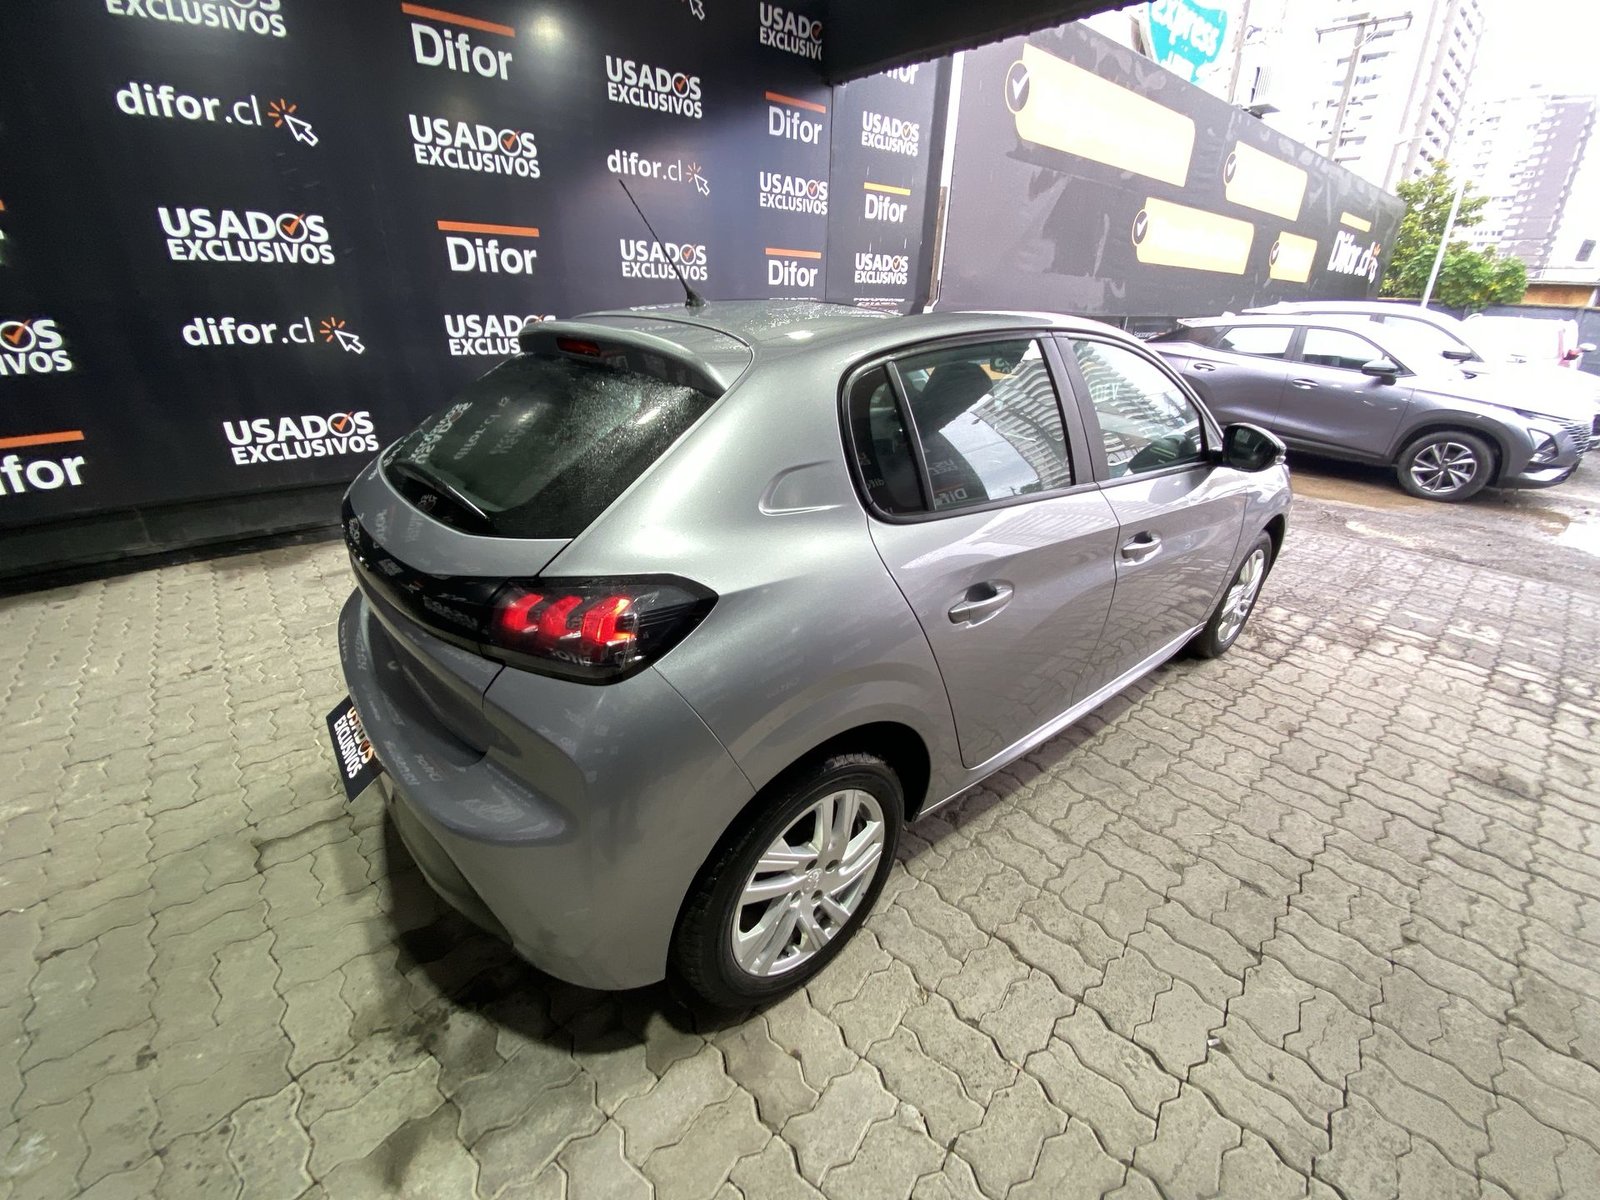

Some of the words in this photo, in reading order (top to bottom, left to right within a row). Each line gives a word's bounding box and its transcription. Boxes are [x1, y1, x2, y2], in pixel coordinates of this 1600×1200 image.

[105, 0, 287, 37] EXCLUSIVOS
[411, 22, 513, 80] Difor
[759, 27, 822, 61] EXCLUSIV
[605, 55, 702, 100] USADOS
[116, 82, 262, 126] difor.cl
[607, 82, 703, 119] EXCLUSIVOS
[408, 113, 538, 158] USADOS
[768, 105, 823, 144] Difor
[862, 110, 920, 142] USADOS
[413, 143, 541, 178] EXCLUSIVOS
[861, 131, 919, 157] EXCLUSIVOS
[606, 149, 682, 182] difor.cl
[759, 171, 828, 200] USADOS
[759, 193, 828, 215] EXCLUSIVOS
[864, 193, 908, 223] Difor
[157, 206, 329, 243] USADOS
[166, 238, 336, 265] EXCLUSIVOS
[445, 236, 538, 275] Difor
[619, 238, 707, 265] USADOS
[855, 253, 909, 273] USADOS
[768, 259, 818, 287] Difor
[854, 270, 908, 285] EXCLUSIVOS
[182, 316, 315, 346] difor.cl
[444, 314, 557, 338] USAD
[222, 410, 375, 446] USADOS
[231, 433, 379, 466] EXCLUSIVOS
[333, 714, 363, 779] EXCLUSIVOS
